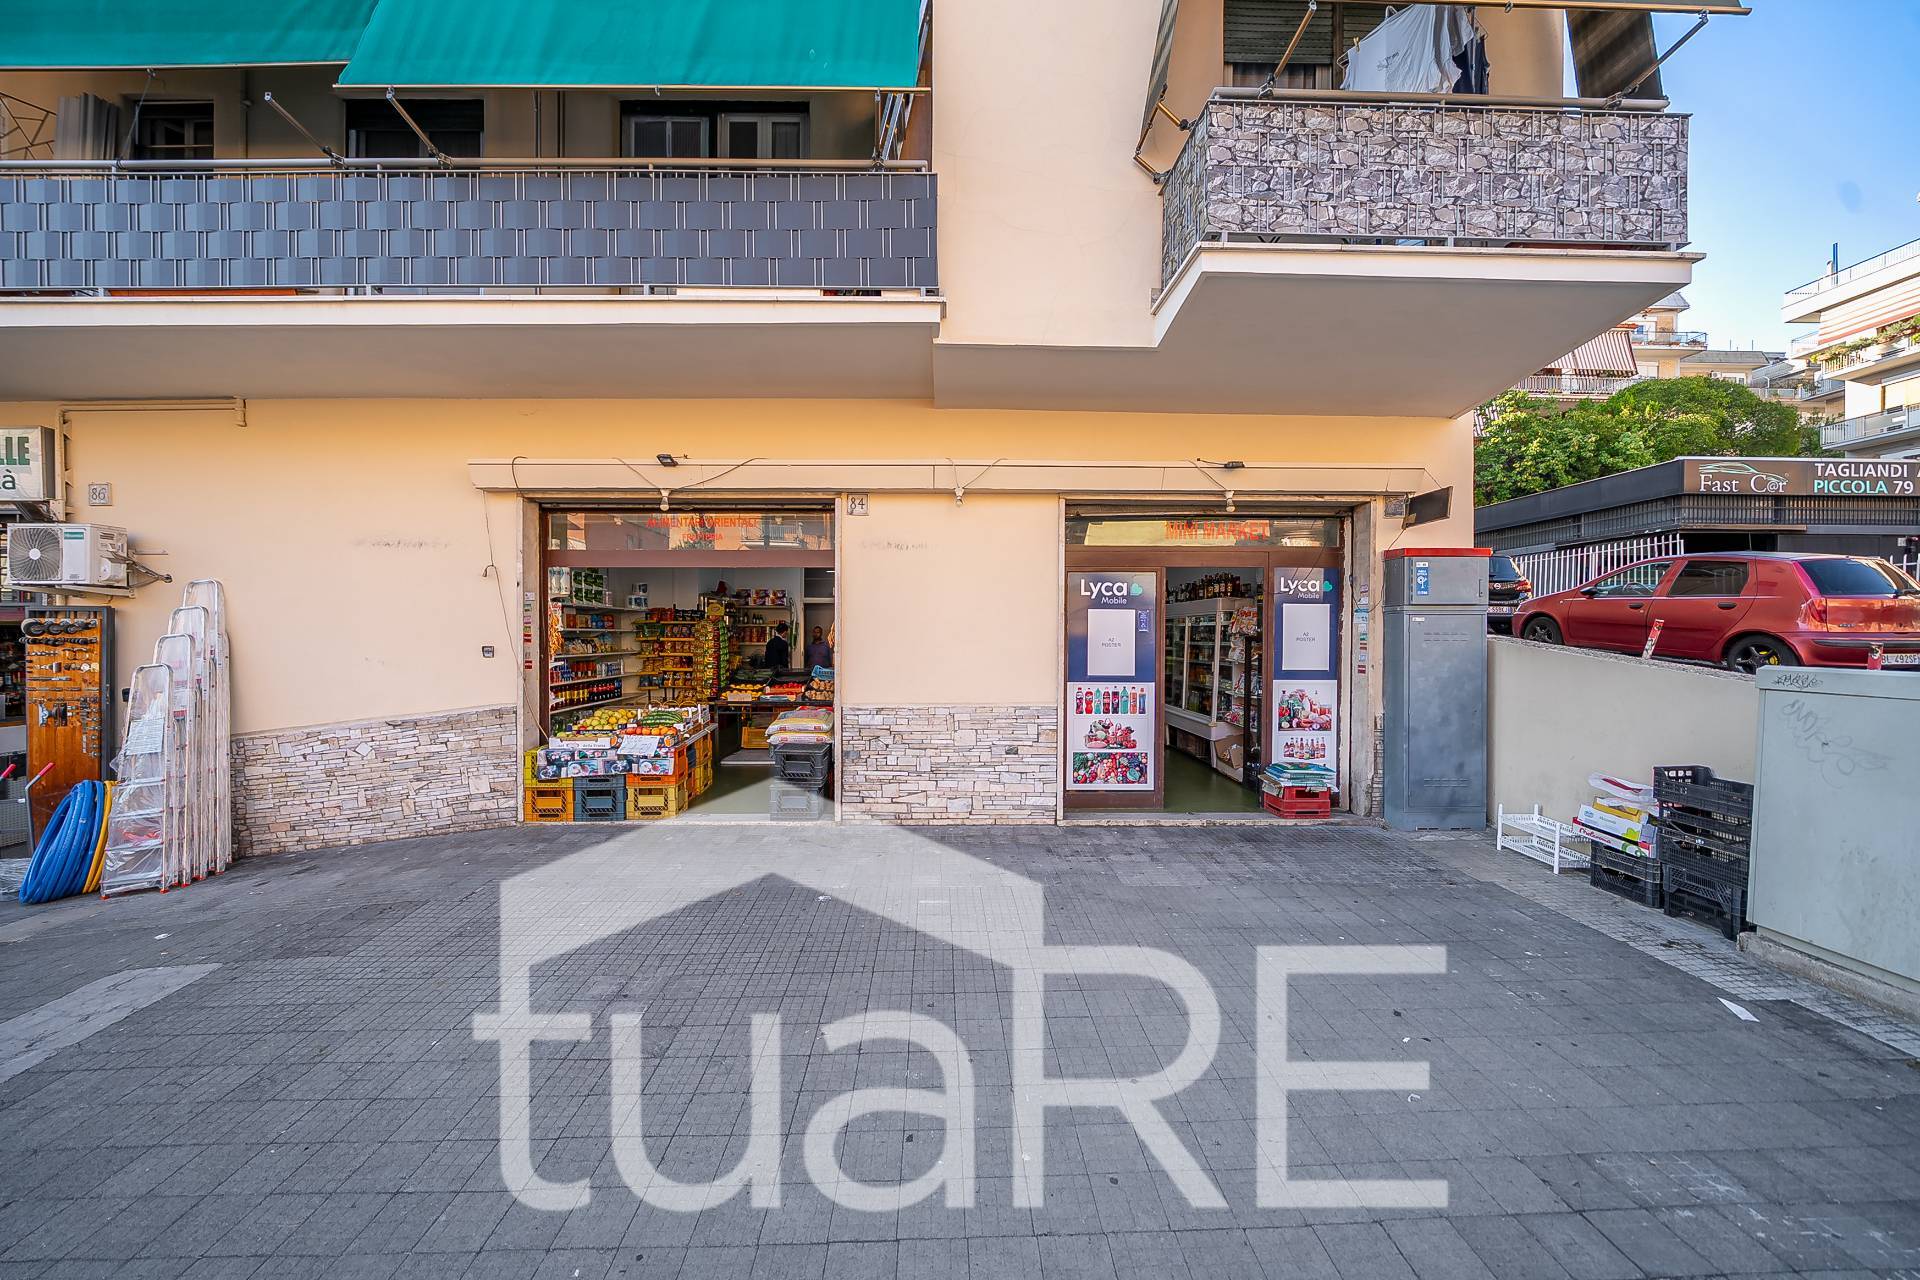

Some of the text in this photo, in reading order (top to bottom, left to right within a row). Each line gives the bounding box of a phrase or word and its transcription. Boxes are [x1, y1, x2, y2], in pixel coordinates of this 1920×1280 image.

[0, 436, 30, 466] LE
[1814, 463, 1908, 478] TAGLIANDI
[1700, 473, 1740, 492] Fast
[1813, 480, 1914, 494] PICCOLA 79
[91, 487, 107, 501] 86
[850, 496, 866, 510] 84
[1168, 520, 1267, 541] MINI MARKET
[1080, 578, 1128, 599] Lyca
[1280, 577, 1320, 595] Lyca
[1101, 597, 1128, 605] Mobile
